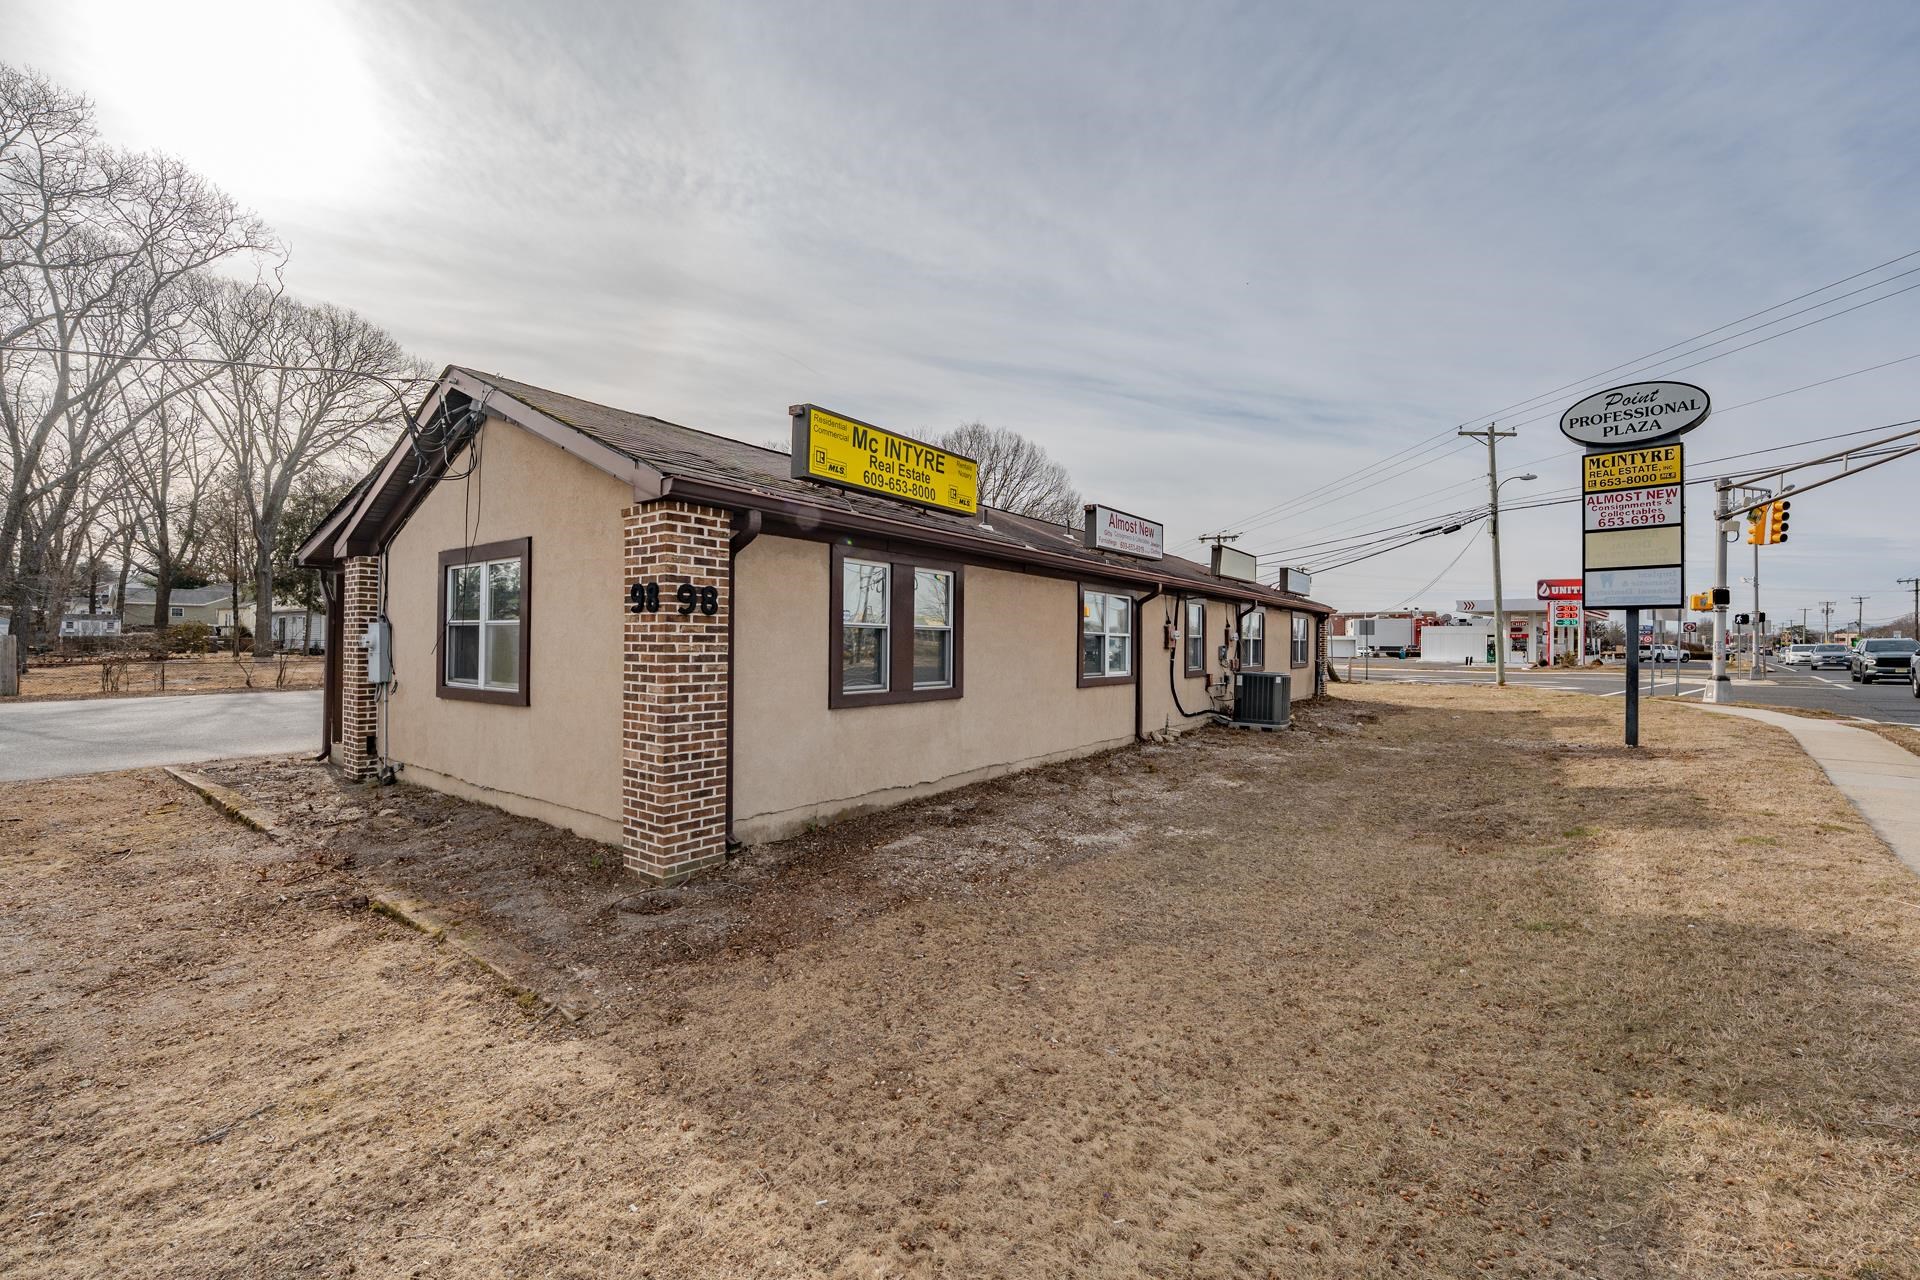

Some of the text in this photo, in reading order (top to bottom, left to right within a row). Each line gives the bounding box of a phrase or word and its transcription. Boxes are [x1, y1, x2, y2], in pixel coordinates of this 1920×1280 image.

[1604, 389, 1660, 411] Point
[814, 413, 848, 431] Residential
[1569, 399, 1700, 429] PROFESSIONAL
[813, 424, 850, 442] Commercial
[1603, 419, 1662, 437] PLAZA
[852, 426, 945, 474] Mc INTYRE
[1588, 448, 1675, 470] McINTYRE
[869, 454, 931, 484] Real Estate
[1589, 469, 1615, 478] REAL
[863, 470, 936, 501] 609-653-8000
[1599, 473, 1657, 488] 653-8000
[1587, 487, 1678, 506] ALMOST NEW
[1591, 500, 1662, 512] Consignments
[1598, 513, 1665, 528] 653-6919
[1600, 507, 1663, 518] Collectables
[1108, 512, 1137, 534] Almost
[1139, 521, 1155, 538] New
[630, 582, 660, 613] 98
[677, 583, 718, 615] 98
